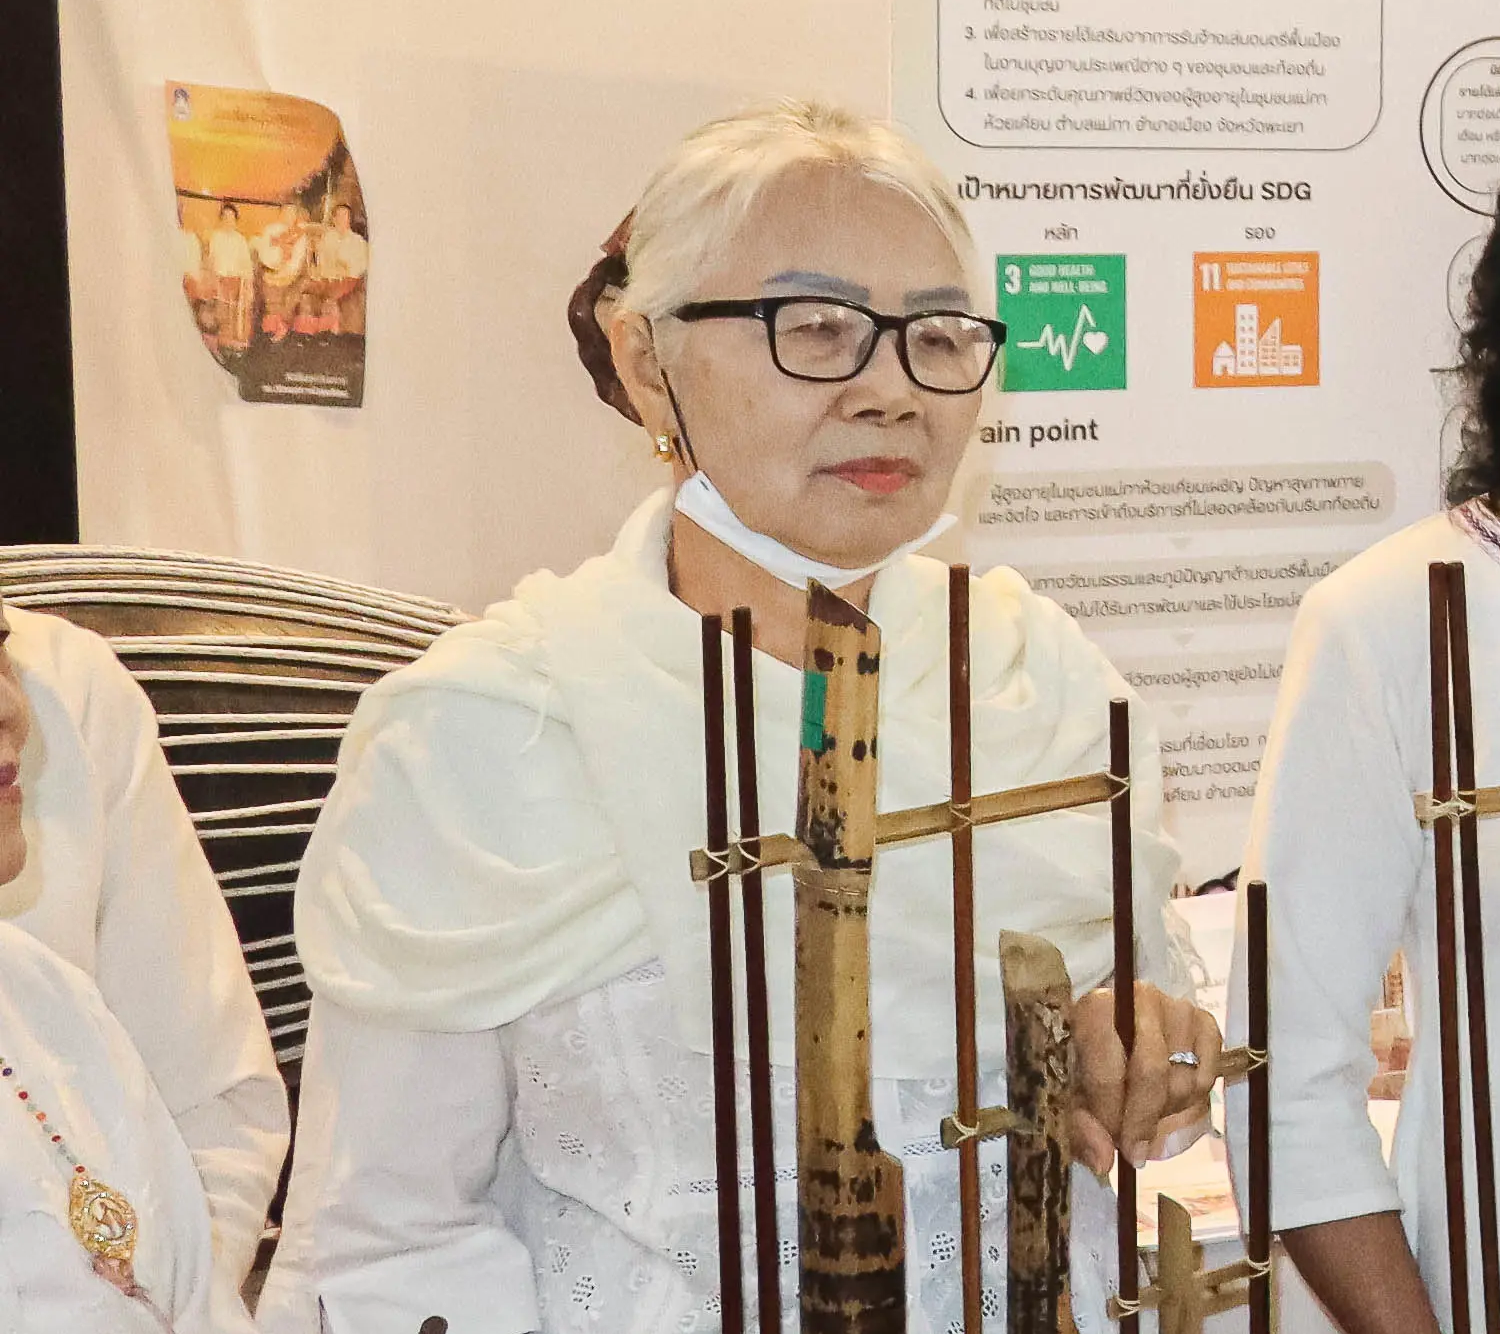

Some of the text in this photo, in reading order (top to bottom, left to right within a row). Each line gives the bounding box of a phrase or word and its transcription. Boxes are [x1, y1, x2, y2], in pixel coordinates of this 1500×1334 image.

[956, 169, 1312, 202] เป้าหมายการพัฒนาที่ยั่งยืน SDG
[1044, 222, 1079, 241] หลัก
[1244, 224, 1276, 241] รอง
[1004, 262, 1022, 296] 3
[1201, 262, 1224, 292] 11
[979, 419, 1099, 448] ain point
